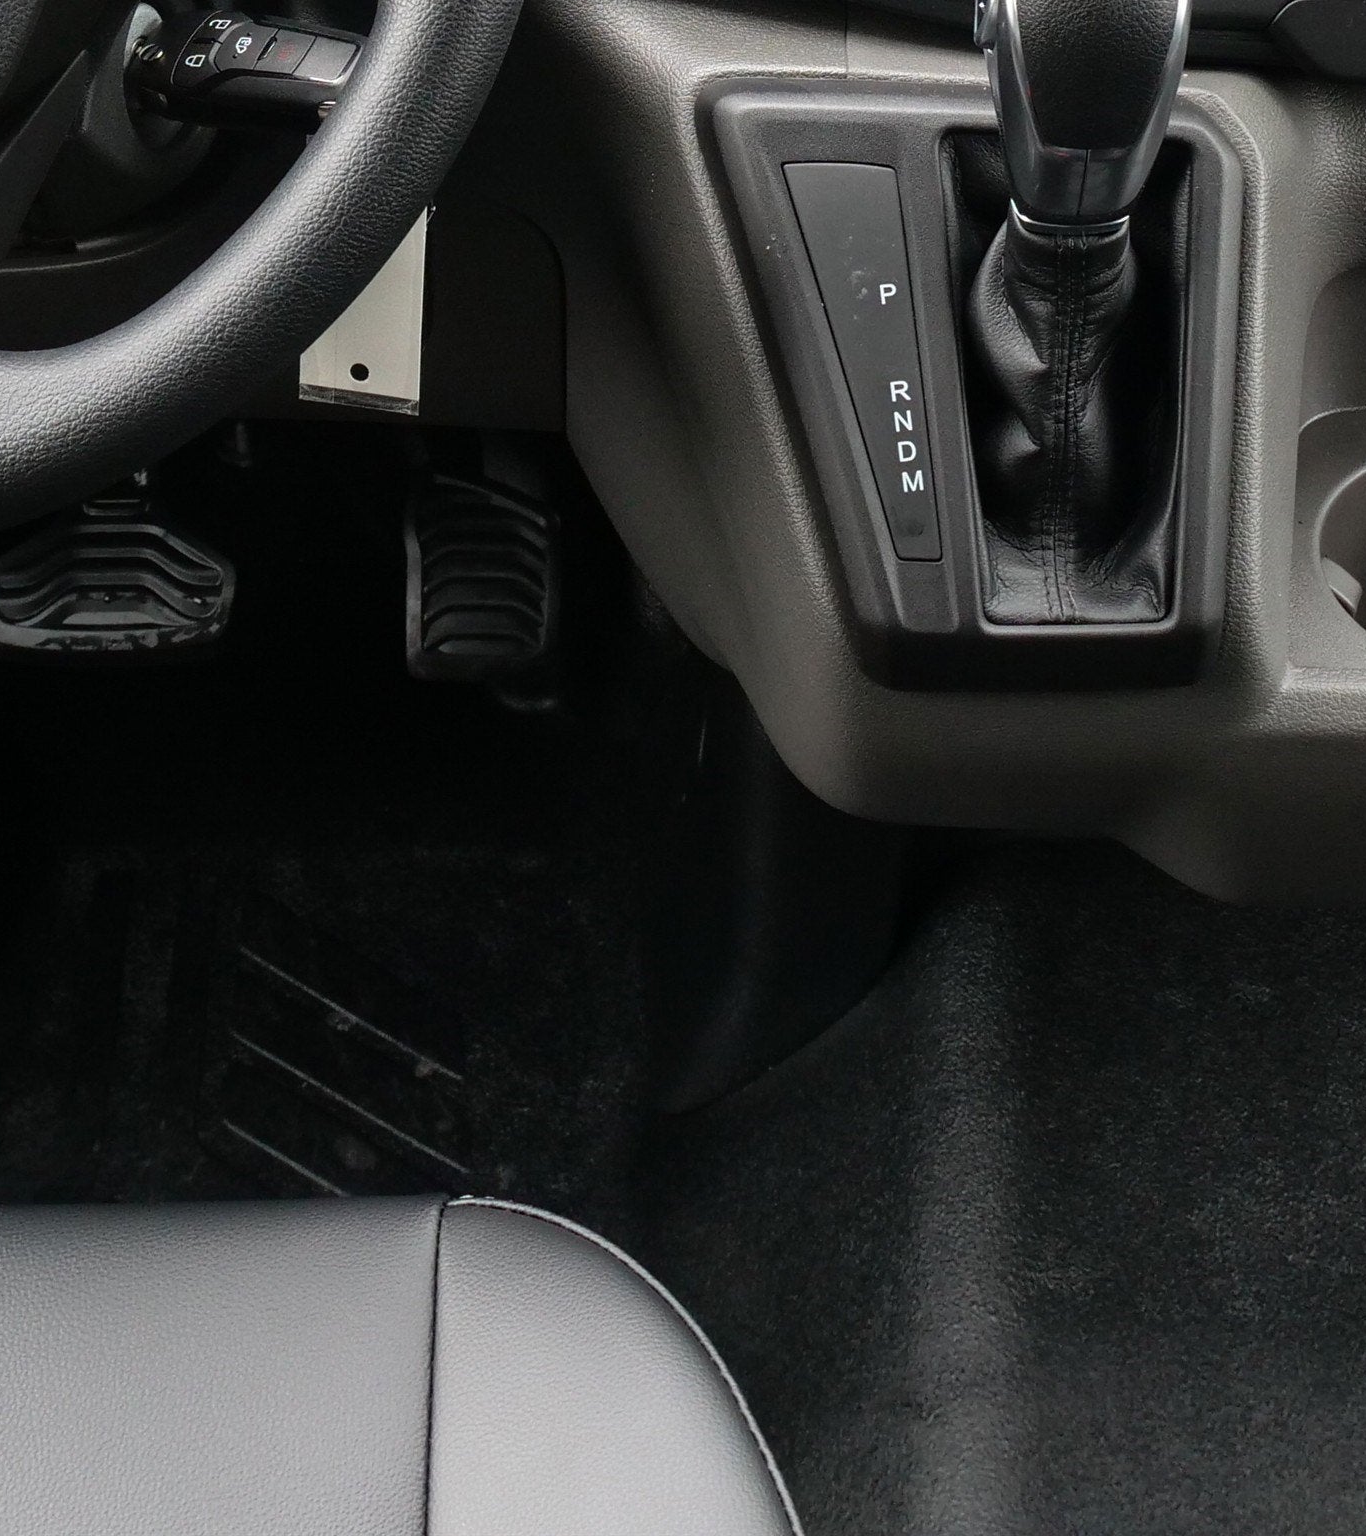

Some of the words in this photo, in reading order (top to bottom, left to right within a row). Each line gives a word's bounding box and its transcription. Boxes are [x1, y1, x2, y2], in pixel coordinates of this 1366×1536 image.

[880, 284, 896, 304] P
[890, 381, 911, 402] R
[894, 410, 912, 432] N
[898, 441, 916, 462] D
[902, 470, 924, 492] M
